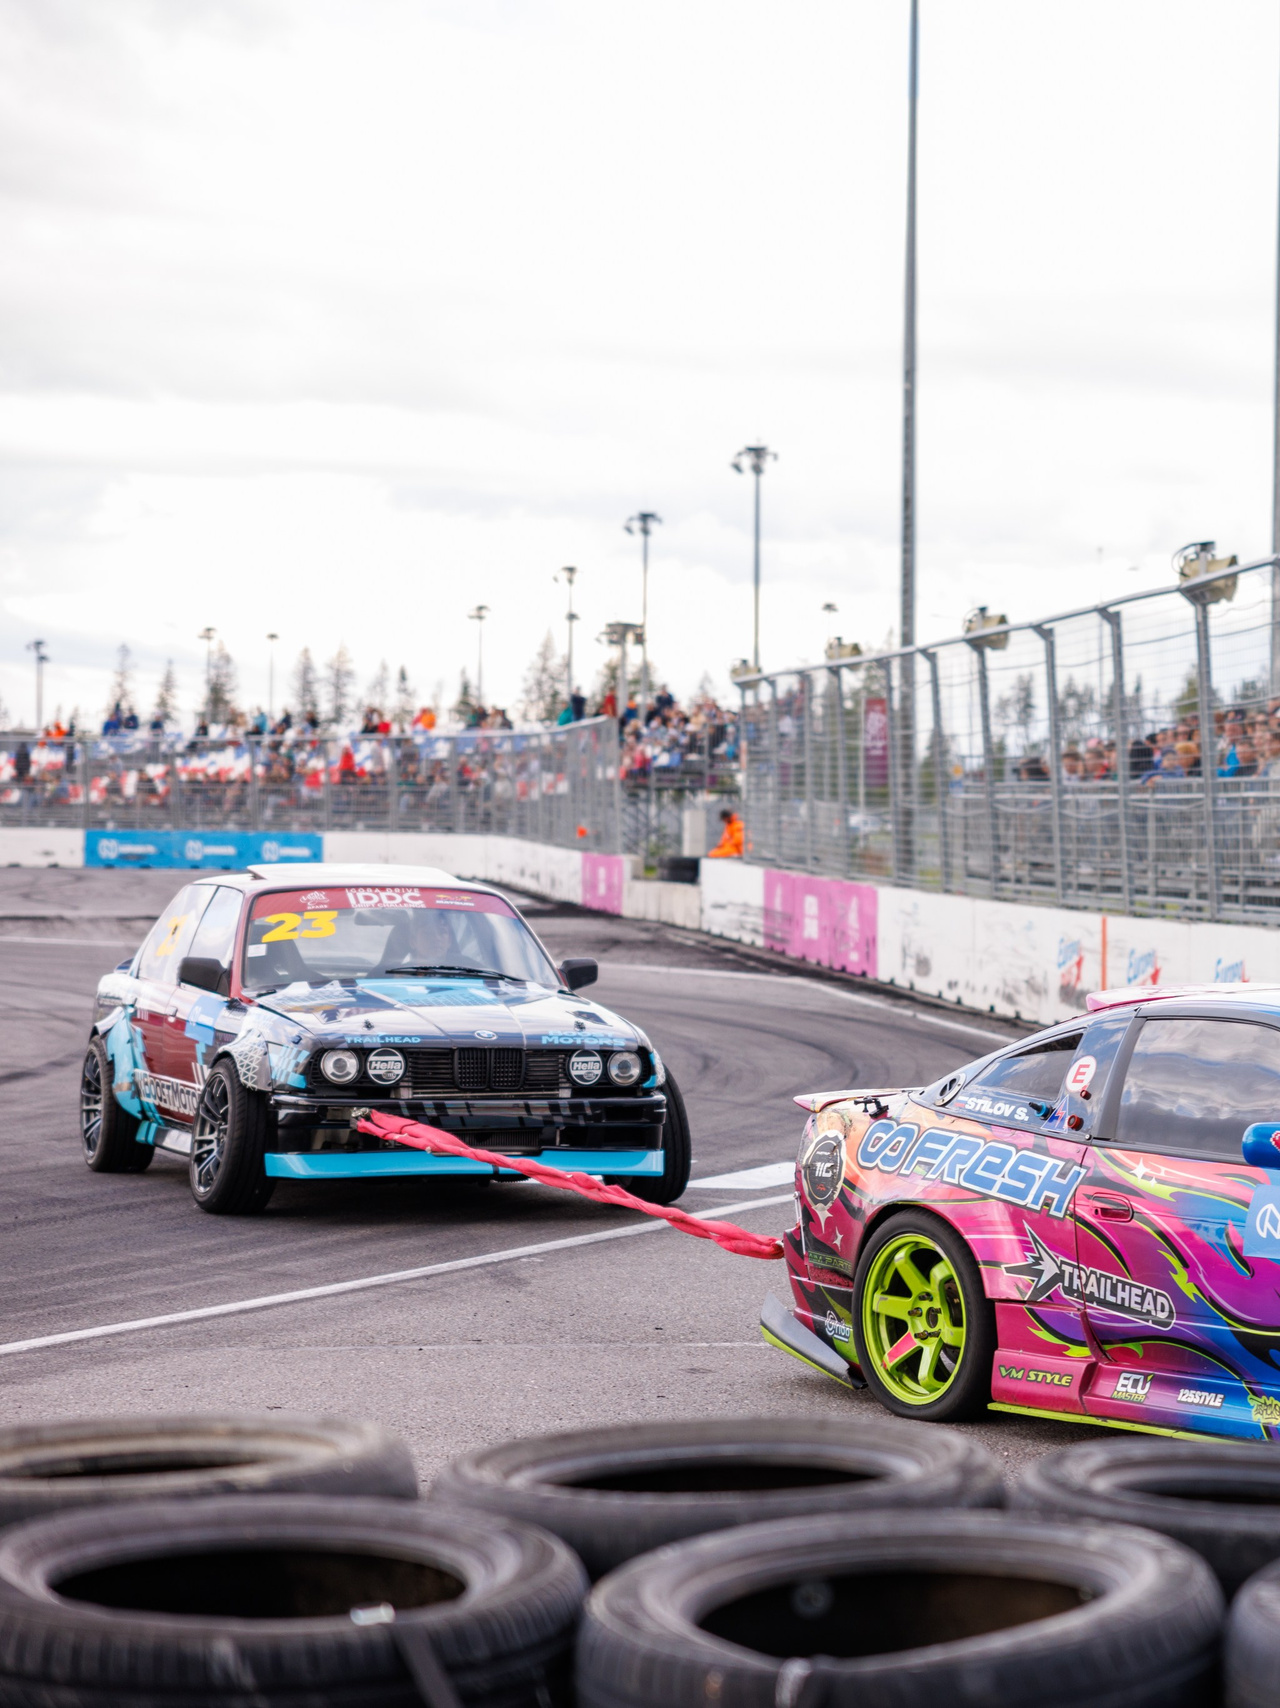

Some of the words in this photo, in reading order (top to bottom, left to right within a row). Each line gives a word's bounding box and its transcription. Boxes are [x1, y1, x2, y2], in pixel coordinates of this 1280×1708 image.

[348, 891, 424, 905] IDDC
[261, 911, 338, 943] 23
[344, 1036, 421, 1044] TRAILHEAD
[541, 1036, 627, 1046] MOTORS
[370, 1061, 402, 1070] Hella
[572, 1061, 600, 1071] Hella
[1072, 1064, 1091, 1084] E
[965, 1097, 1015, 1117] STILOV
[1014, 1106, 1029, 1122] S.
[1060, 1263, 1171, 1319] TRAILHEAD
[999, 1364, 1024, 1380] VM
[1026, 1369, 1074, 1387] STYLE
[1115, 1372, 1153, 1395] ECU
[1111, 1390, 1146, 1403] MASTER
[1176, 1388, 1225, 1409] 125STYLE
